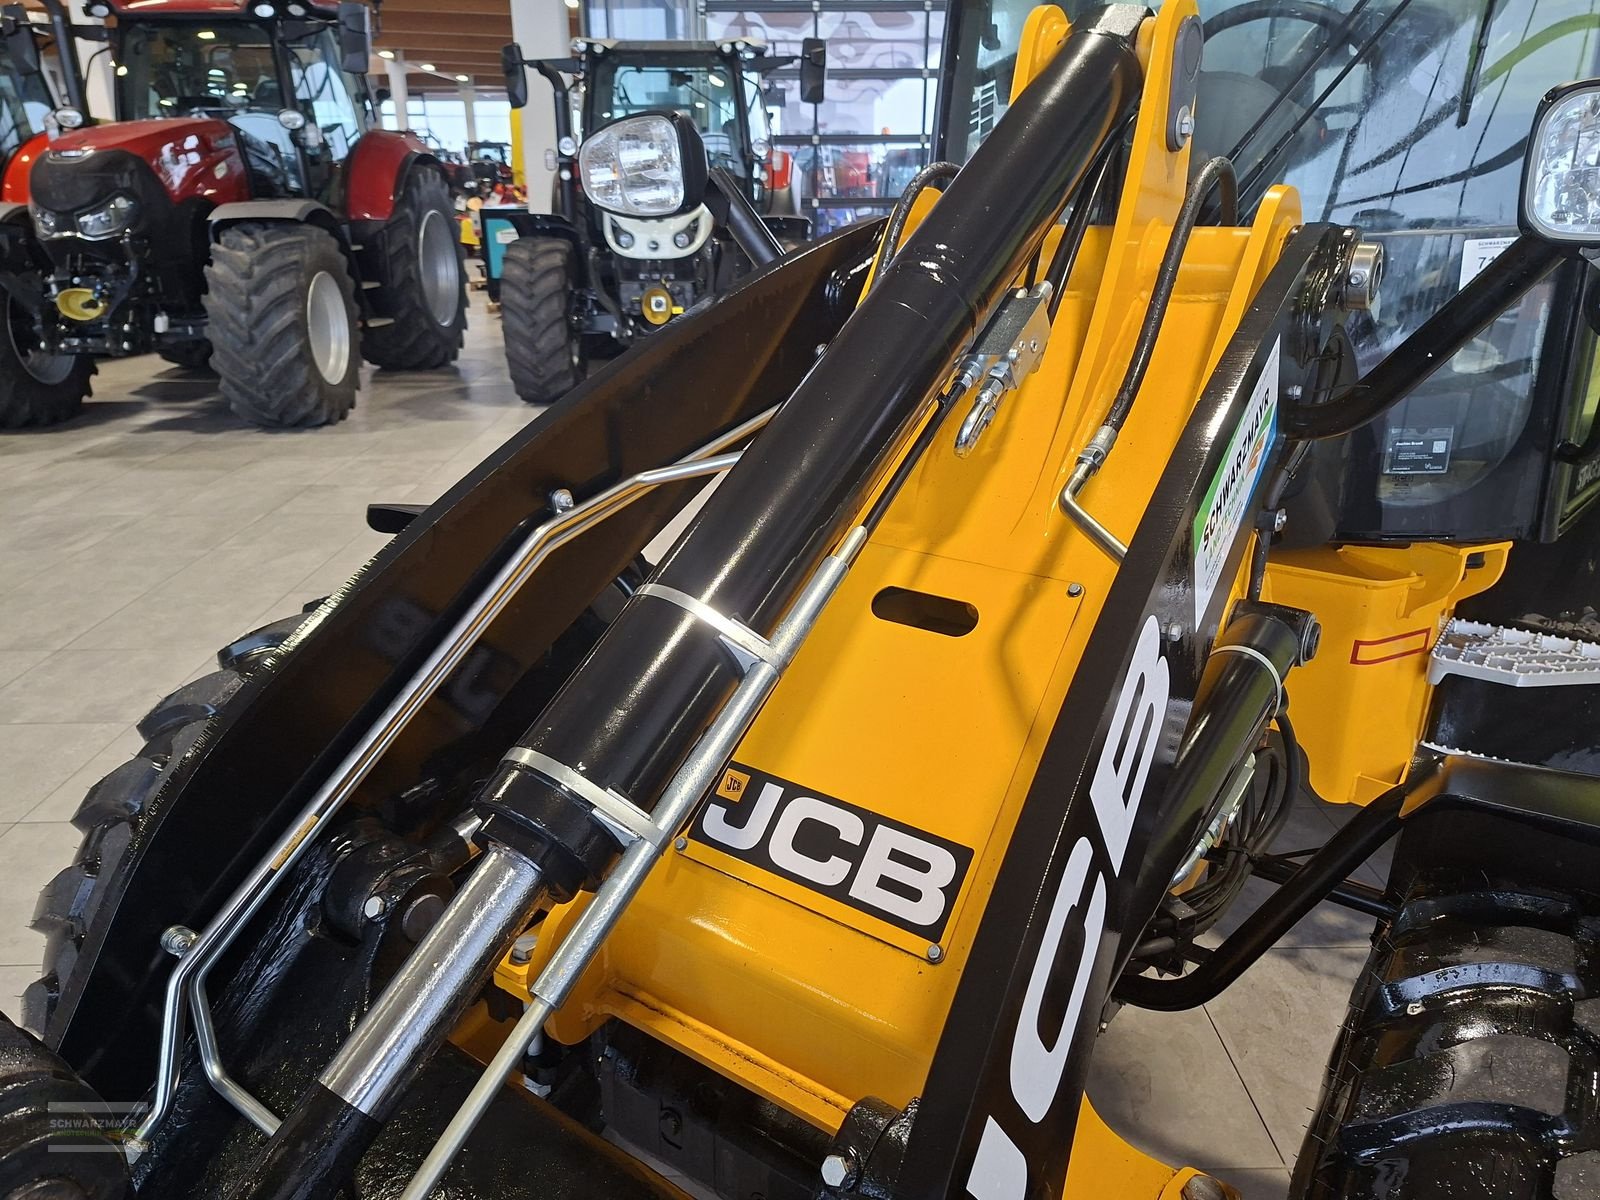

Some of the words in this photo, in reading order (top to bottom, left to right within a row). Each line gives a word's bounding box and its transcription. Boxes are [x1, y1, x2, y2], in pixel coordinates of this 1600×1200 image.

[1203, 386, 1271, 552] SCHWARZMAYR
[1204, 472, 1246, 572] LANDTECHNIK
[727, 776, 742, 791] JCB
[702, 782, 957, 926] JCB
